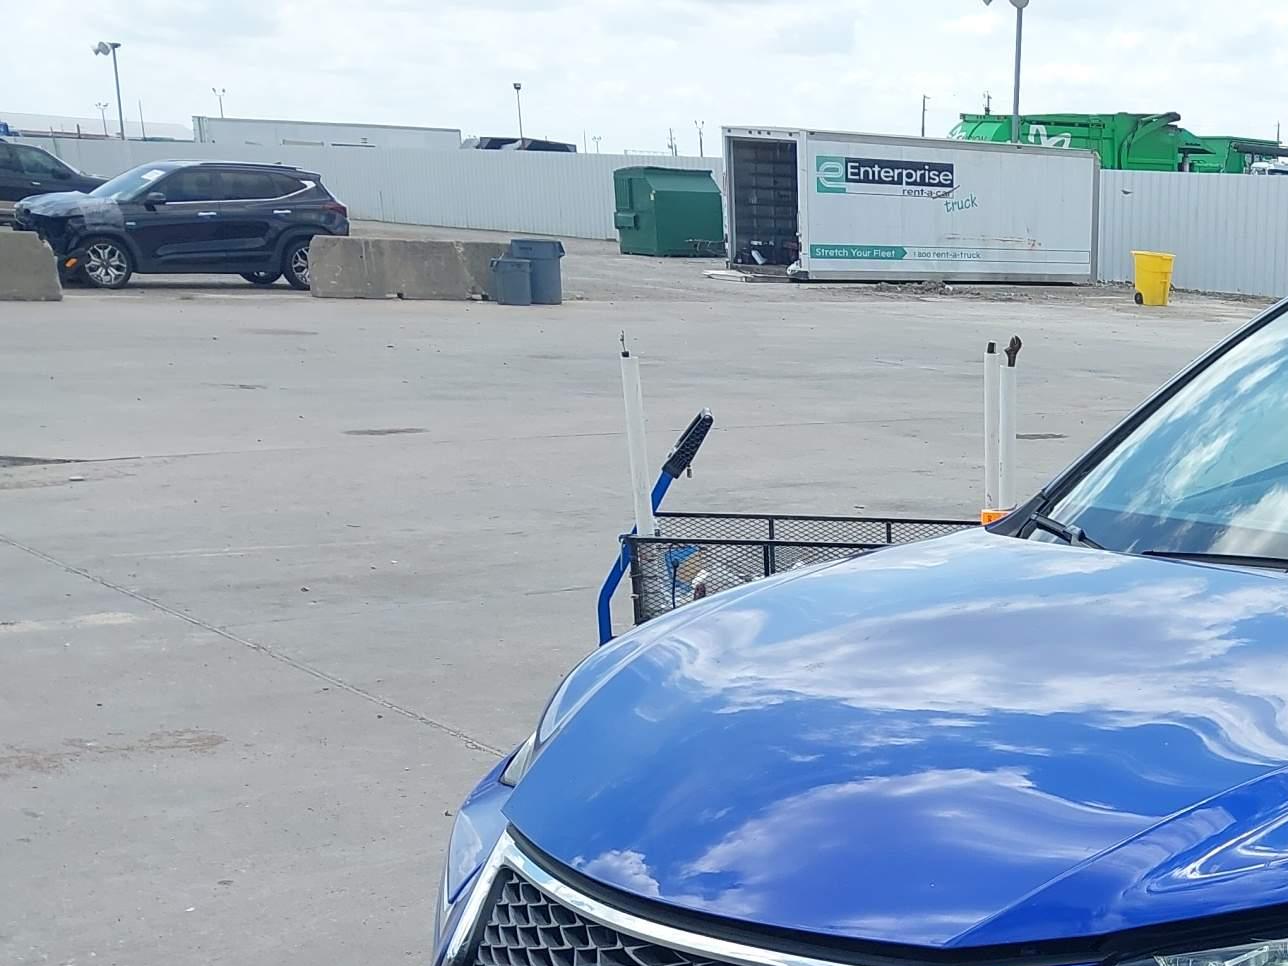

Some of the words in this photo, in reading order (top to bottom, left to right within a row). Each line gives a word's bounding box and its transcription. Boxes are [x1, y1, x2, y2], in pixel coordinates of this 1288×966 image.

[846, 161, 953, 187] Enterprise
[943, 194, 978, 213] truck
[815, 247, 849, 257] Stretch
[850, 248, 871, 257] Your
[873, 249, 896, 258] Fleet
